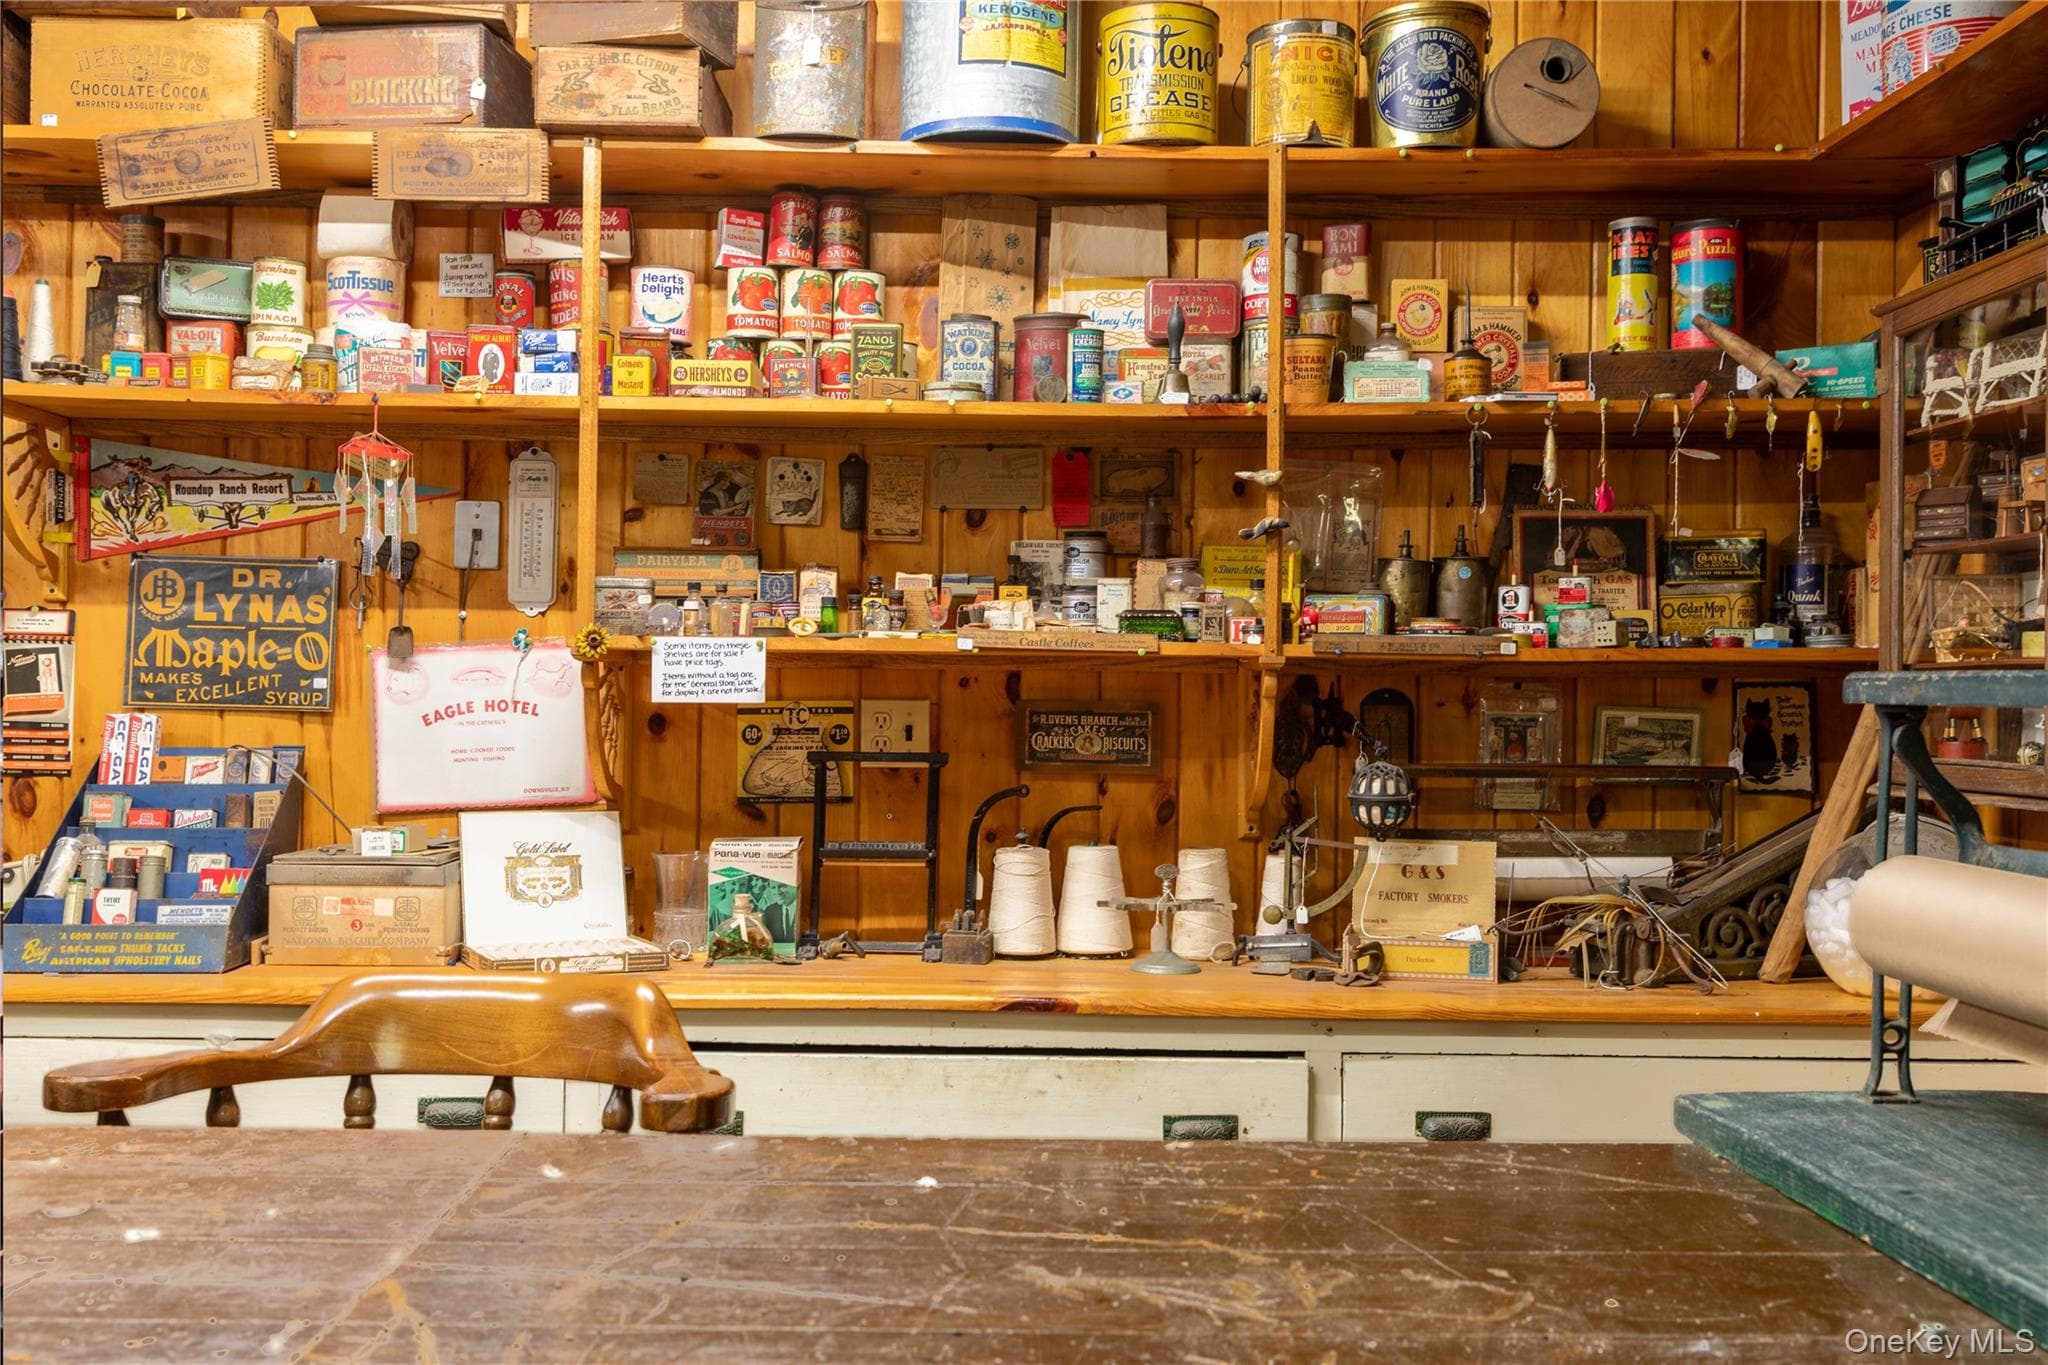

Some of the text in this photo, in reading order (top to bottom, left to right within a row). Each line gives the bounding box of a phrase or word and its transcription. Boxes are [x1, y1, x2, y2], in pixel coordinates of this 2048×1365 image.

[978, 4, 1056, 24] KEROSENE
[1899, 3, 1952, 31] CHEESE
[1931, 31, 1955, 43] FREE
[1107, 23, 1217, 77] Tiolene
[1384, 50, 1396, 63] THE
[1396, 35, 1418, 52] JACOB
[1440, 31, 1467, 50] PACKING
[76, 45, 211, 77] HERSHEY'S
[1377, 54, 1480, 102] WHITE ROSE
[70, 80, 209, 100] CHOCOLATE COCOA
[350, 76, 459, 106] BLACKING
[1415, 87, 1448, 97] BRAND
[76, 101, 175, 110] WARRANTED ABSOLUTELY
[641, 96, 681, 114] BRAND
[1401, 93, 1460, 108] PURE LARD
[1185, 111, 1200, 119] GAS
[205, 142, 250, 155] CANDY
[480, 151, 525, 161] CANDY
[561, 233, 577, 241] ICE
[1330, 227, 1358, 241] BON
[1329, 241, 1358, 254] AMI
[1699, 237, 1737, 256] Puzzle
[255, 263, 297, 276] Burnham
[641, 283, 685, 300] Delight
[1400, 285, 1441, 297] ARM HAMMER
[1192, 295, 1218, 303] INDIA
[734, 315, 778, 328] TOMATOES
[1090, 309, 1119, 330] Nancy
[255, 331, 303, 344] Burnham
[471, 333, 491, 343] PRINCE
[667, 327, 687, 336] PEARS
[946, 328, 991, 340] WATKINS
[1489, 321, 1522, 342] HAMMER
[857, 335, 895, 347] ZANOL
[1026, 337, 1061, 351] Velvet
[1422, 334, 1440, 345] SODA
[857, 350, 877, 358] QUALITY
[1286, 355, 1327, 365] SULTANA
[952, 362, 986, 371] COCOA
[689, 366, 732, 383] HERSHEY'S
[1194, 373, 1226, 381] SCARLET
[1294, 373, 1322, 381] Butter
[1826, 376, 1866, 386] HI-SPEED
[617, 379, 644, 390] Mustard
[1502, 374, 1521, 390] SODA
[712, 387, 747, 397] ALMONDS
[175, 482, 283, 497] Roundup Ranch Resort
[702, 519, 746, 528] MENDETS
[636, 554, 708, 567] DAIRYLEA
[1696, 552, 1738, 562] CRAYOLA
[1218, 565, 1253, 575] Duro Art
[231, 567, 293, 590] DR.
[1605, 574, 1634, 584] GAS
[193, 581, 332, 625] LYNAS'
[1787, 590, 1822, 604] Quink
[137, 604, 188, 623] TRADE MARK
[1704, 601, 1727, 618] Mop
[663, 641, 751, 651] Some items these
[1018, 637, 1054, 648] Castle
[1055, 637, 1095, 649] Coffees
[664, 650, 694, 659] shelves
[723, 649, 739, 658] sale
[663, 658, 704, 667] have price
[139, 672, 203, 686] MAKES
[662, 672, 686, 681] Items
[687, 671, 718, 680] without
[726, 671, 739, 680] tag
[175, 673, 282, 703] EXCELLENT
[661, 679, 737, 689] for the Store
[264, 691, 324, 706] SYRUP
[661, 688, 673, 697] for
[674, 688, 700, 698] display
[720, 687, 732, 695] not
[421, 698, 541, 728] EAGLE HOTEL
[785, 707, 809, 725] TC
[1080, 715, 1118, 725] BRANCH
[1069, 725, 1107, 737] CAKES
[1030, 731, 1146, 754] CRACKERS BISCUITS
[513, 840, 573, 857] Gold Label
[1400, 863, 1446, 880] G & S
[1378, 890, 1469, 904] FACTORY SMOKERS
[70, 932, 92, 940] GOOD
[95, 932, 118, 940] POINT
[121, 932, 132, 940] TO
[283, 936, 430, 946] NATIONAL BISCUIT COMPANY
[22, 938, 52, 964] Buy
[119, 943, 185, 953] THUMB TACKS
[50, 955, 202, 966] AMERICAN UPHOLSTERY NAILS
